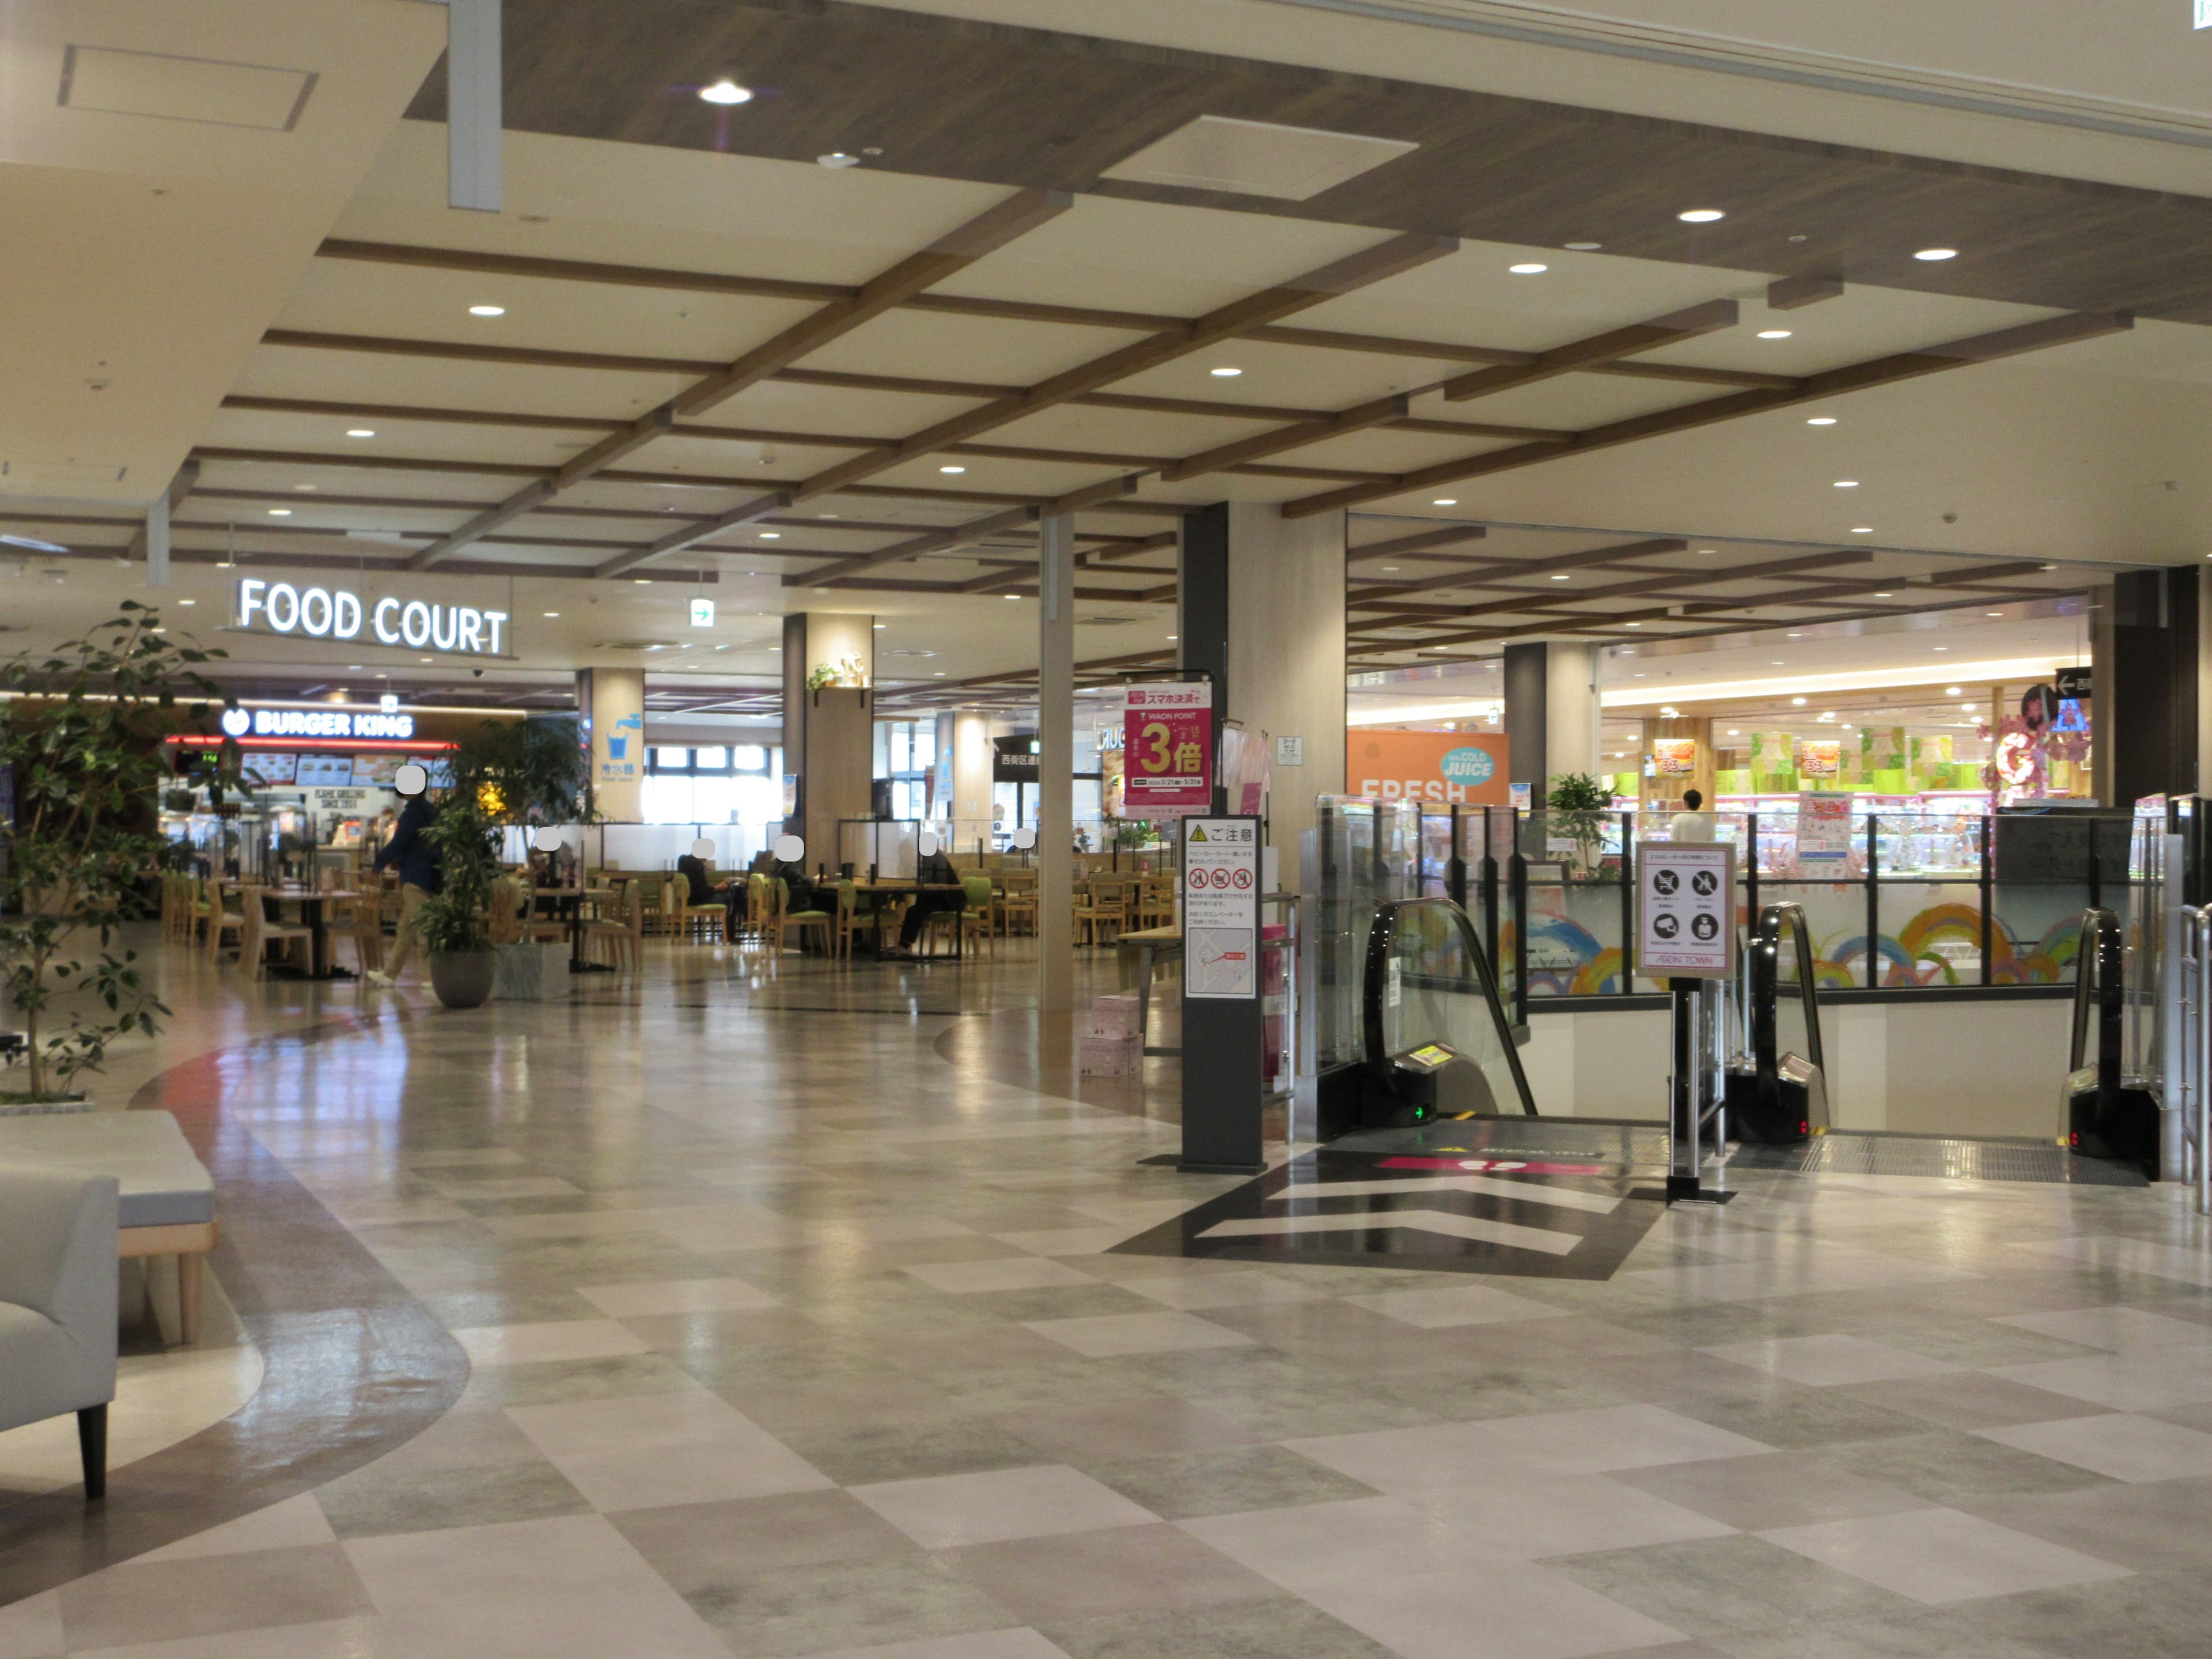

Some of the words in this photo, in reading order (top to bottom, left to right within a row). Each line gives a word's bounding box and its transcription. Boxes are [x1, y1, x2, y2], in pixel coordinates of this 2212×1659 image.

[240, 579, 362, 639] FOOD
[374, 597, 507, 654] COURT
[255, 711, 351, 736] BURGER
[354, 714, 413, 737] KING
[1461, 752, 1486, 762] COLD
[1444, 763, 1492, 777] JUICE
[1362, 779, 1466, 802] FRESH
[1211, 828, 1253, 842] ご注意
[1684, 956, 1713, 964] TOWN
